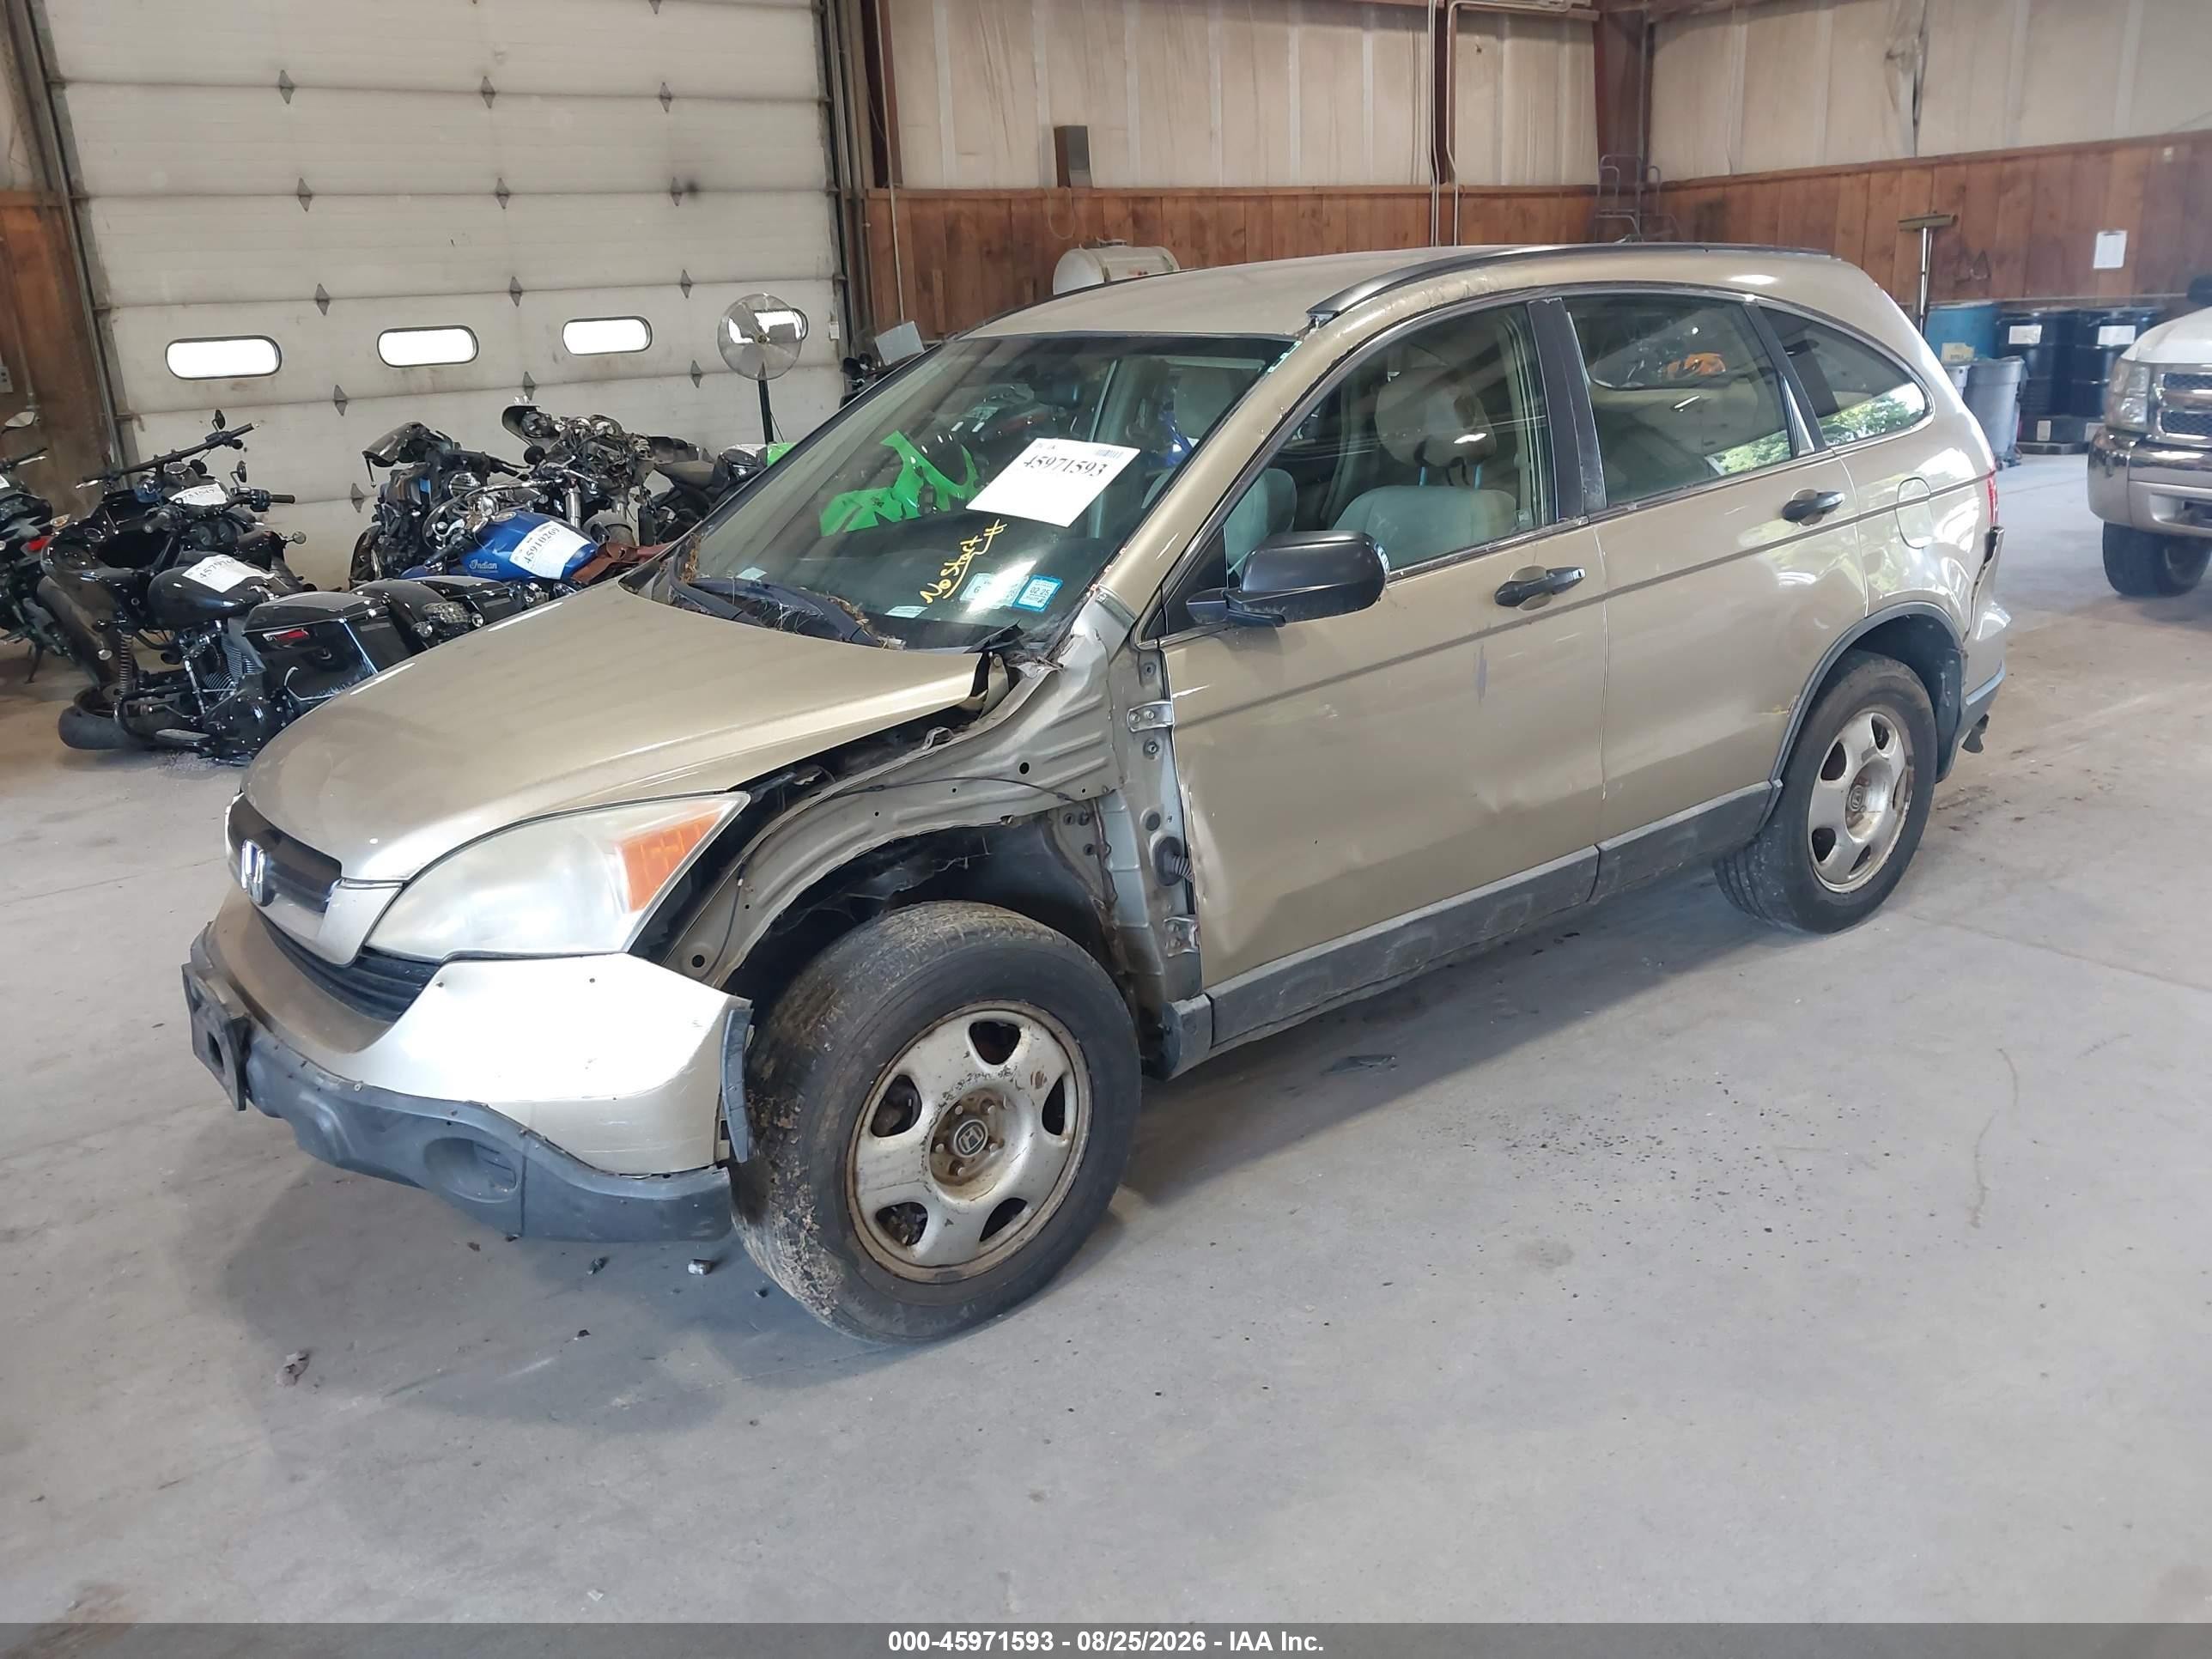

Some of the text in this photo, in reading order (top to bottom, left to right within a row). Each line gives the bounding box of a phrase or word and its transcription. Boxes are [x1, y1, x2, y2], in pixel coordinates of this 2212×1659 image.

[1024, 454, 1108, 477] 45971593
[523, 526, 561, 564] 45910269
[469, 559, 498, 570] Indian
[920, 535, 983, 605] No Start
